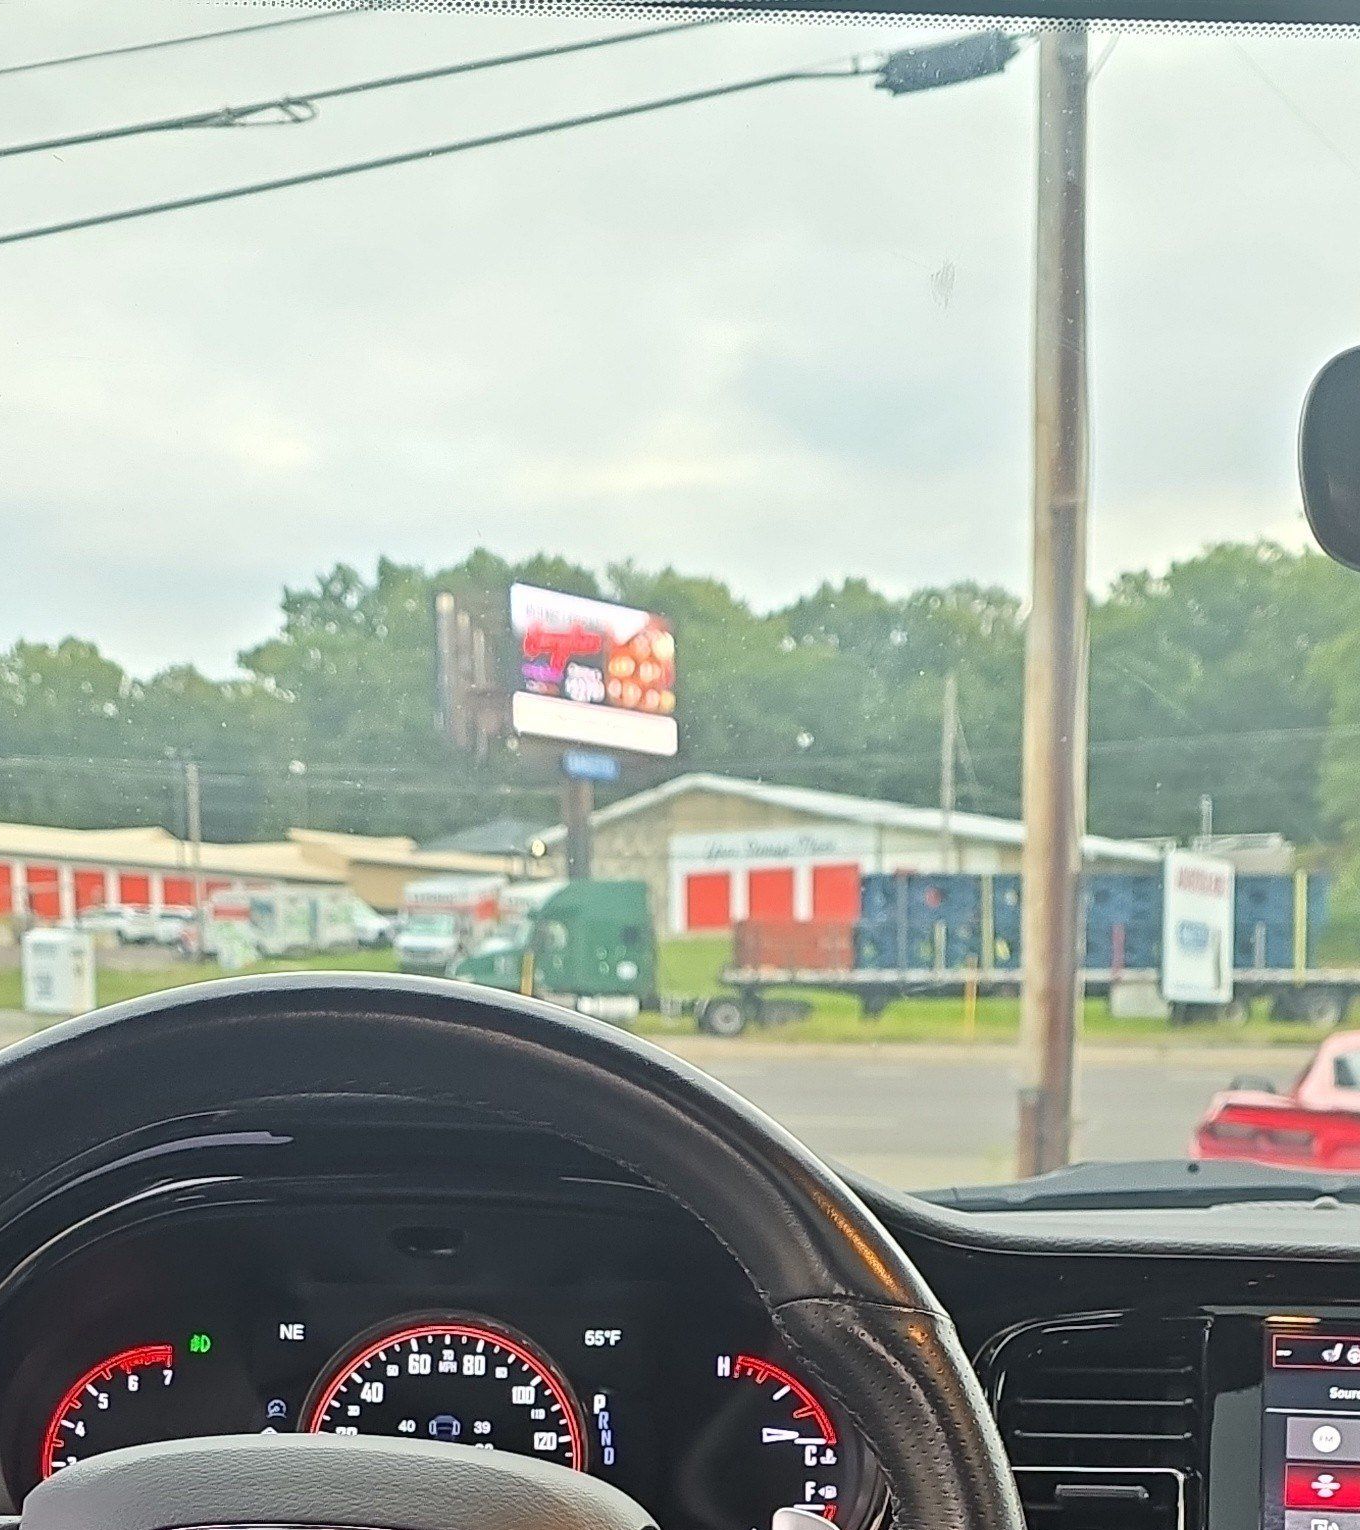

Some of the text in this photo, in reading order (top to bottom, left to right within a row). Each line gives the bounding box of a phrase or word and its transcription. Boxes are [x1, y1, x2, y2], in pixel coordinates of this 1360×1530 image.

[279, 1324, 304, 1340] NE
[408, 1354, 431, 1375] 60
[463, 1354, 486, 1375] 80
[717, 1355, 731, 1377] H
[128, 1375, 139, 1391] 6
[163, 1369, 173, 1385] 7
[97, 1392, 109, 1409] 5
[360, 1382, 384, 1403] 40
[512, 1385, 536, 1405] 100
[593, 1394, 606, 1414] P
[74, 1421, 86, 1437] 4
[398, 1419, 416, 1433] 40
[473, 1420, 491, 1434] 39
[598, 1411, 609, 1429] R
[534, 1432, 557, 1450] 120
[601, 1429, 612, 1446] N
[603, 1447, 614, 1465] D
[804, 1445, 817, 1466] C
[805, 1481, 816, 1501] F
